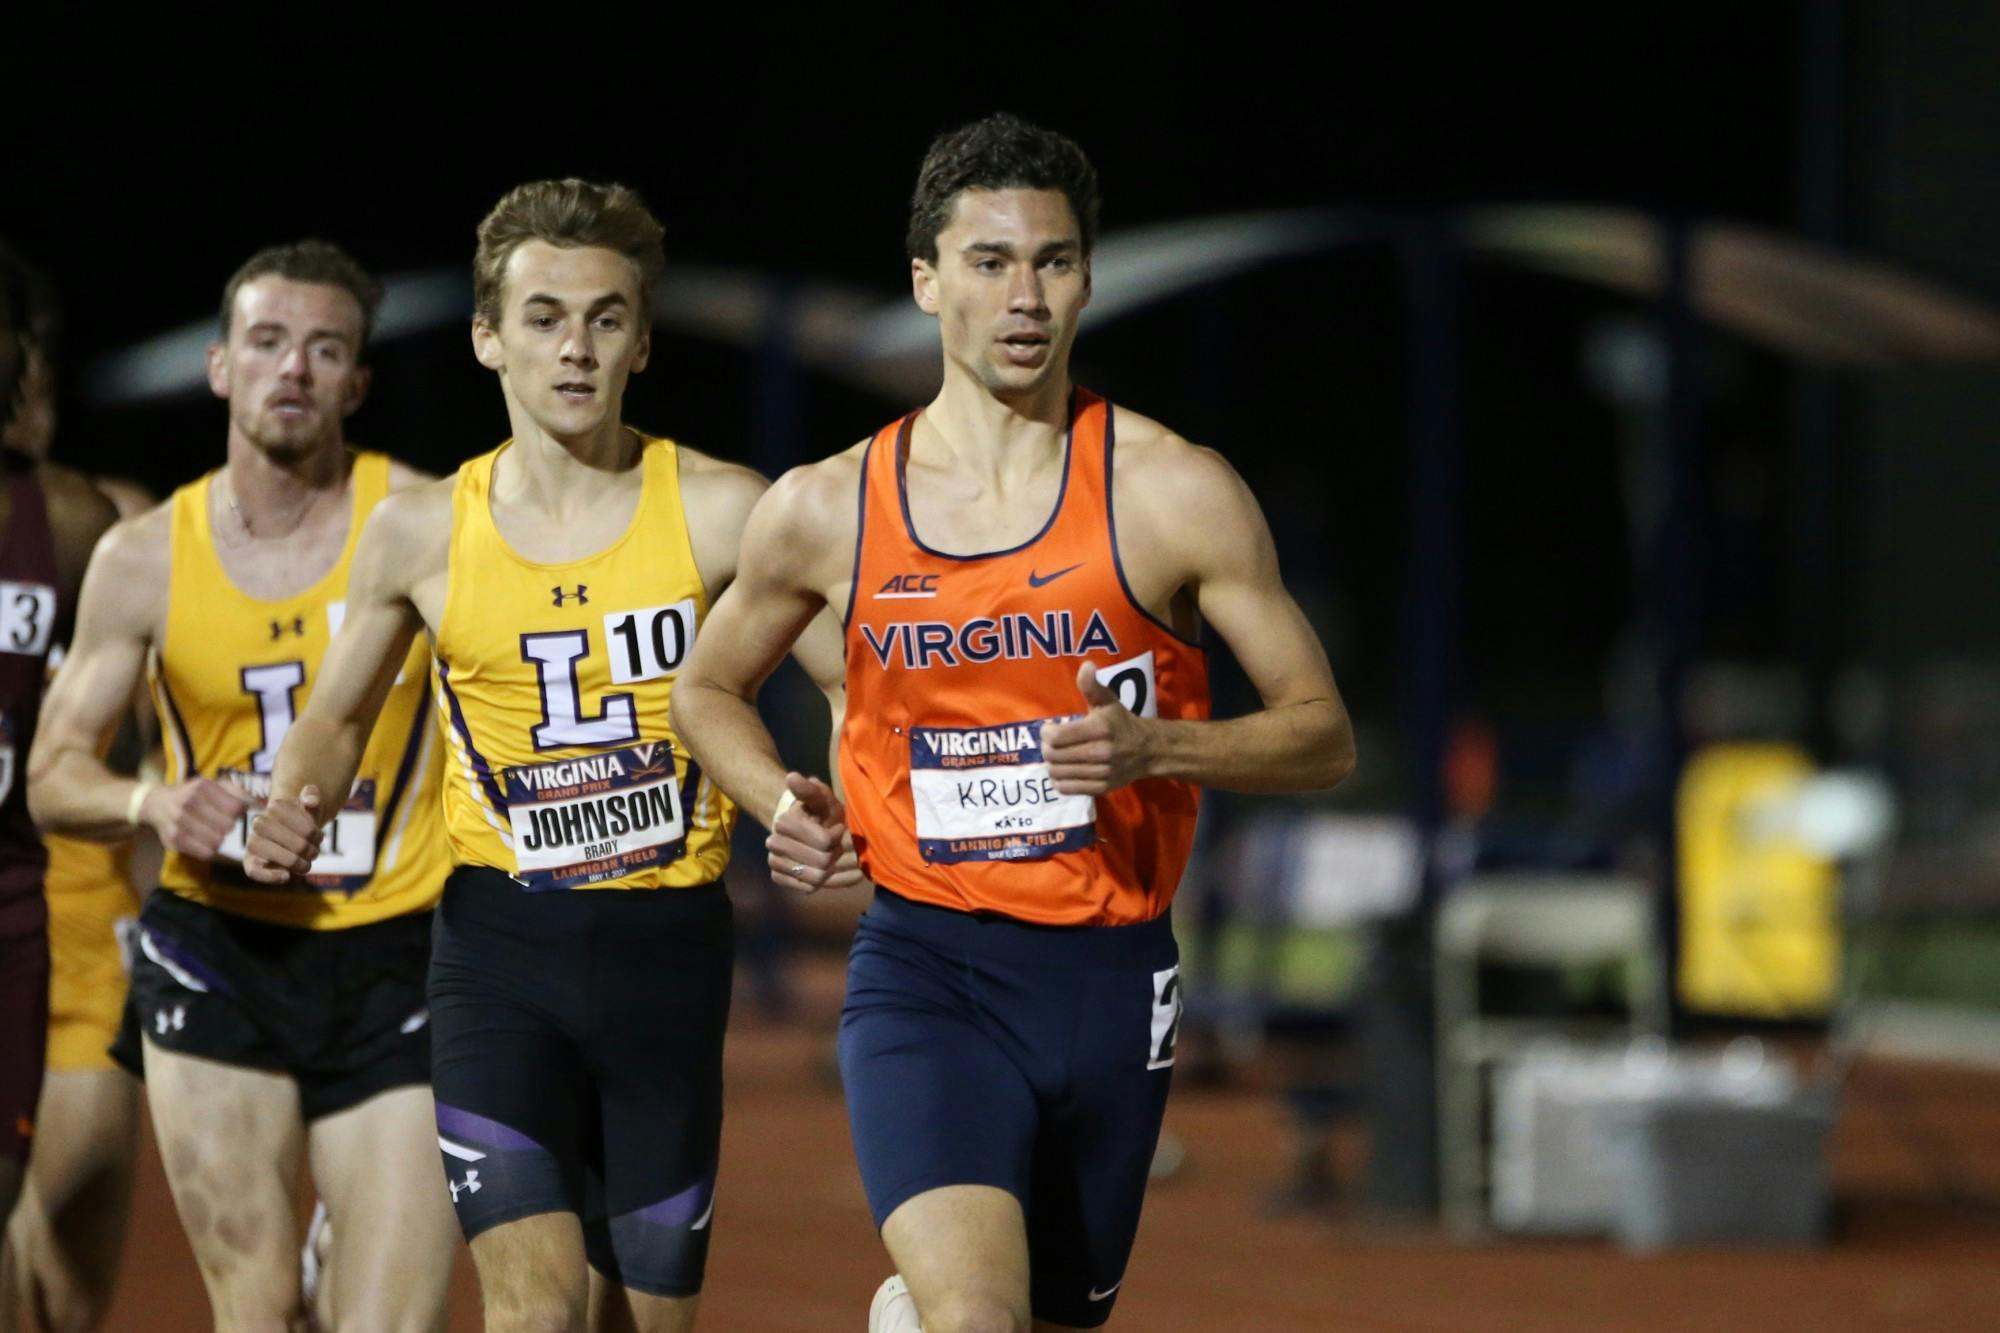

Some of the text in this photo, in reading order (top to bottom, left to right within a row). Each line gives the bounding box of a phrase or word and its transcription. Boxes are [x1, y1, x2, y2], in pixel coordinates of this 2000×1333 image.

[879, 575, 940, 592] ACC
[11, 593, 41, 652] 3
[613, 609, 685, 678] 10
[859, 608, 1120, 671] VIRGINIA
[519, 629, 641, 753] L
[923, 726, 1037, 756] VIRGINIA
[517, 754, 625, 791] VIRGINIA
[942, 752, 1020, 767] GRAND PRIX
[537, 780, 611, 801] GRAND PRIX
[957, 777, 1060, 809] KRUSE
[523, 783, 674, 851] JOHNSON
[584, 840, 618, 860] BRADY
[951, 831, 1065, 853] LANNIGAN FIELD
[552, 849, 657, 881] LANNIGAN FIELD
